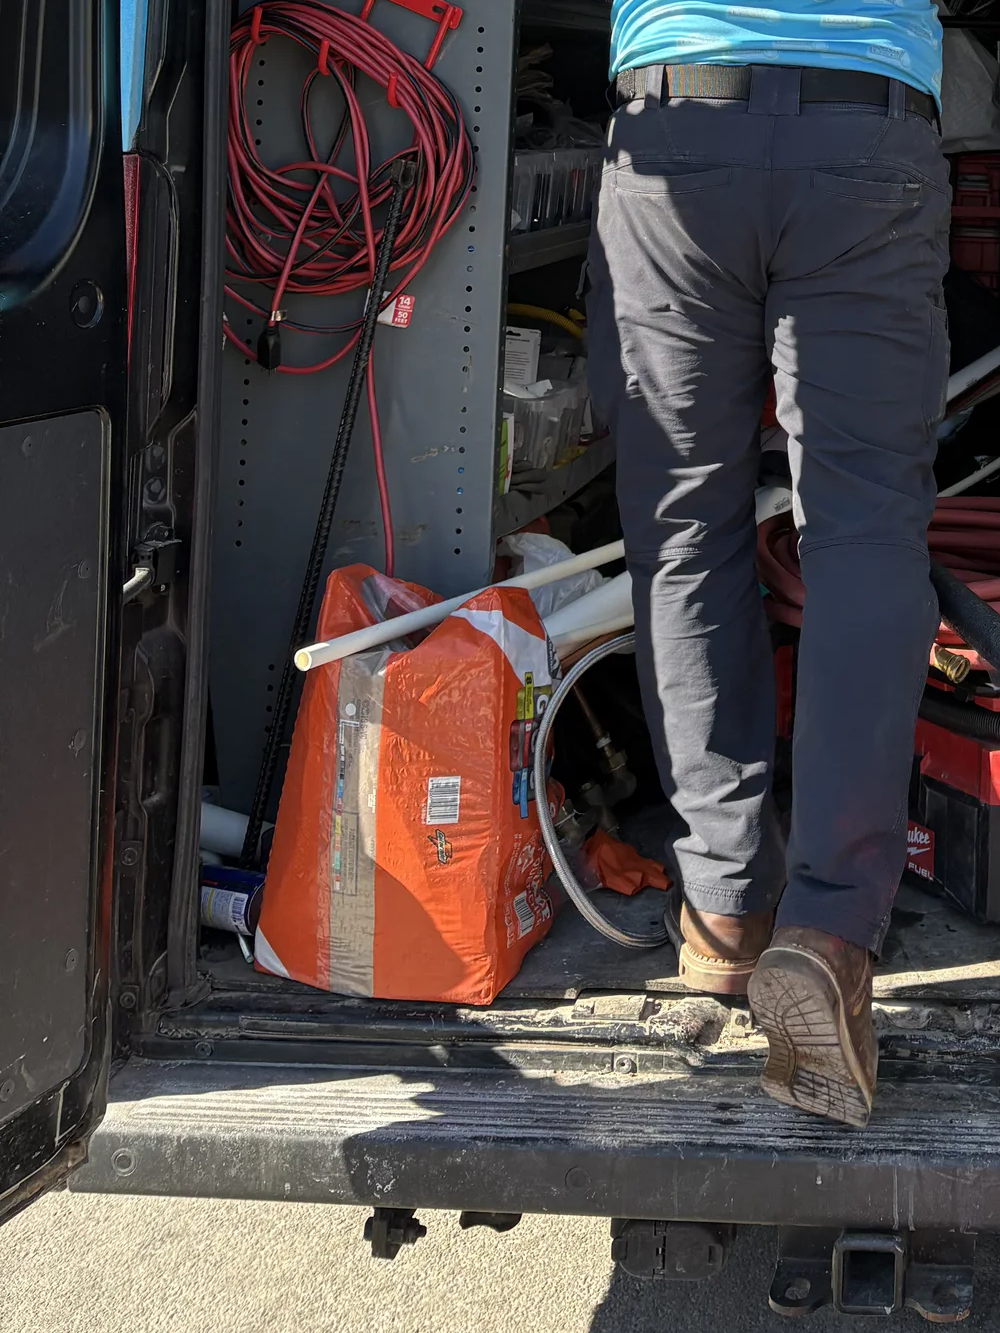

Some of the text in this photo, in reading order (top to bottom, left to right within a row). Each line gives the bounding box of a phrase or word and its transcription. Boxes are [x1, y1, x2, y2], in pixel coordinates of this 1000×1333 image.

[399, 296, 411, 306] 14
[397, 311, 408, 319] 50
[908, 862, 934, 881] FUEL
